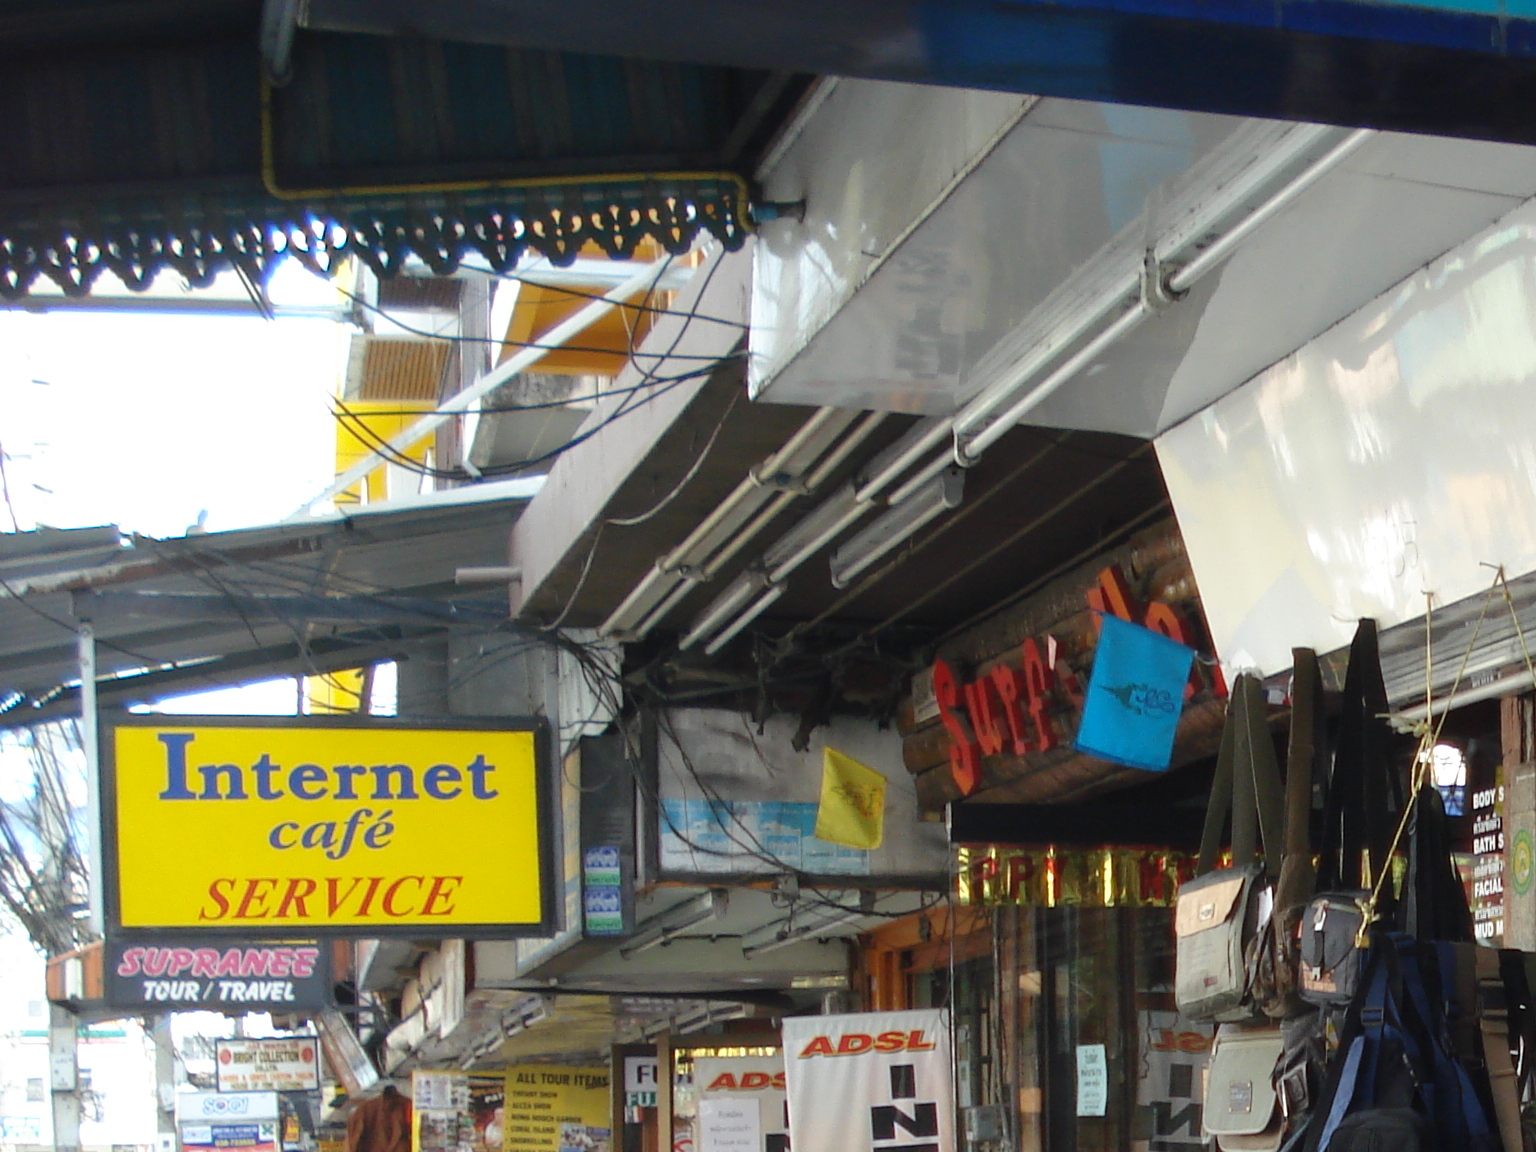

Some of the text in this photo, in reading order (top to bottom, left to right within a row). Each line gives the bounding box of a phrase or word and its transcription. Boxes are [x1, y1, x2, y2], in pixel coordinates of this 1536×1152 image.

[157, 731, 500, 801] Internet
[1472, 788, 1497, 810] BODY
[268, 809, 396, 860] café
[1473, 836, 1496, 856] BATH
[199, 875, 464, 922] SERVICE
[1474, 877, 1503, 898] FACIAL
[1474, 922, 1494, 940] MUD
[117, 947, 320, 978] SUPRANEE
[143, 980, 200, 1002] TOUR
[219, 980, 296, 1002] TRAVEL
[797, 1029, 936, 1059] ADSL
[516, 1072, 609, 1087] ALL TOUR ITEMS
[705, 1071, 787, 1092] ADS
